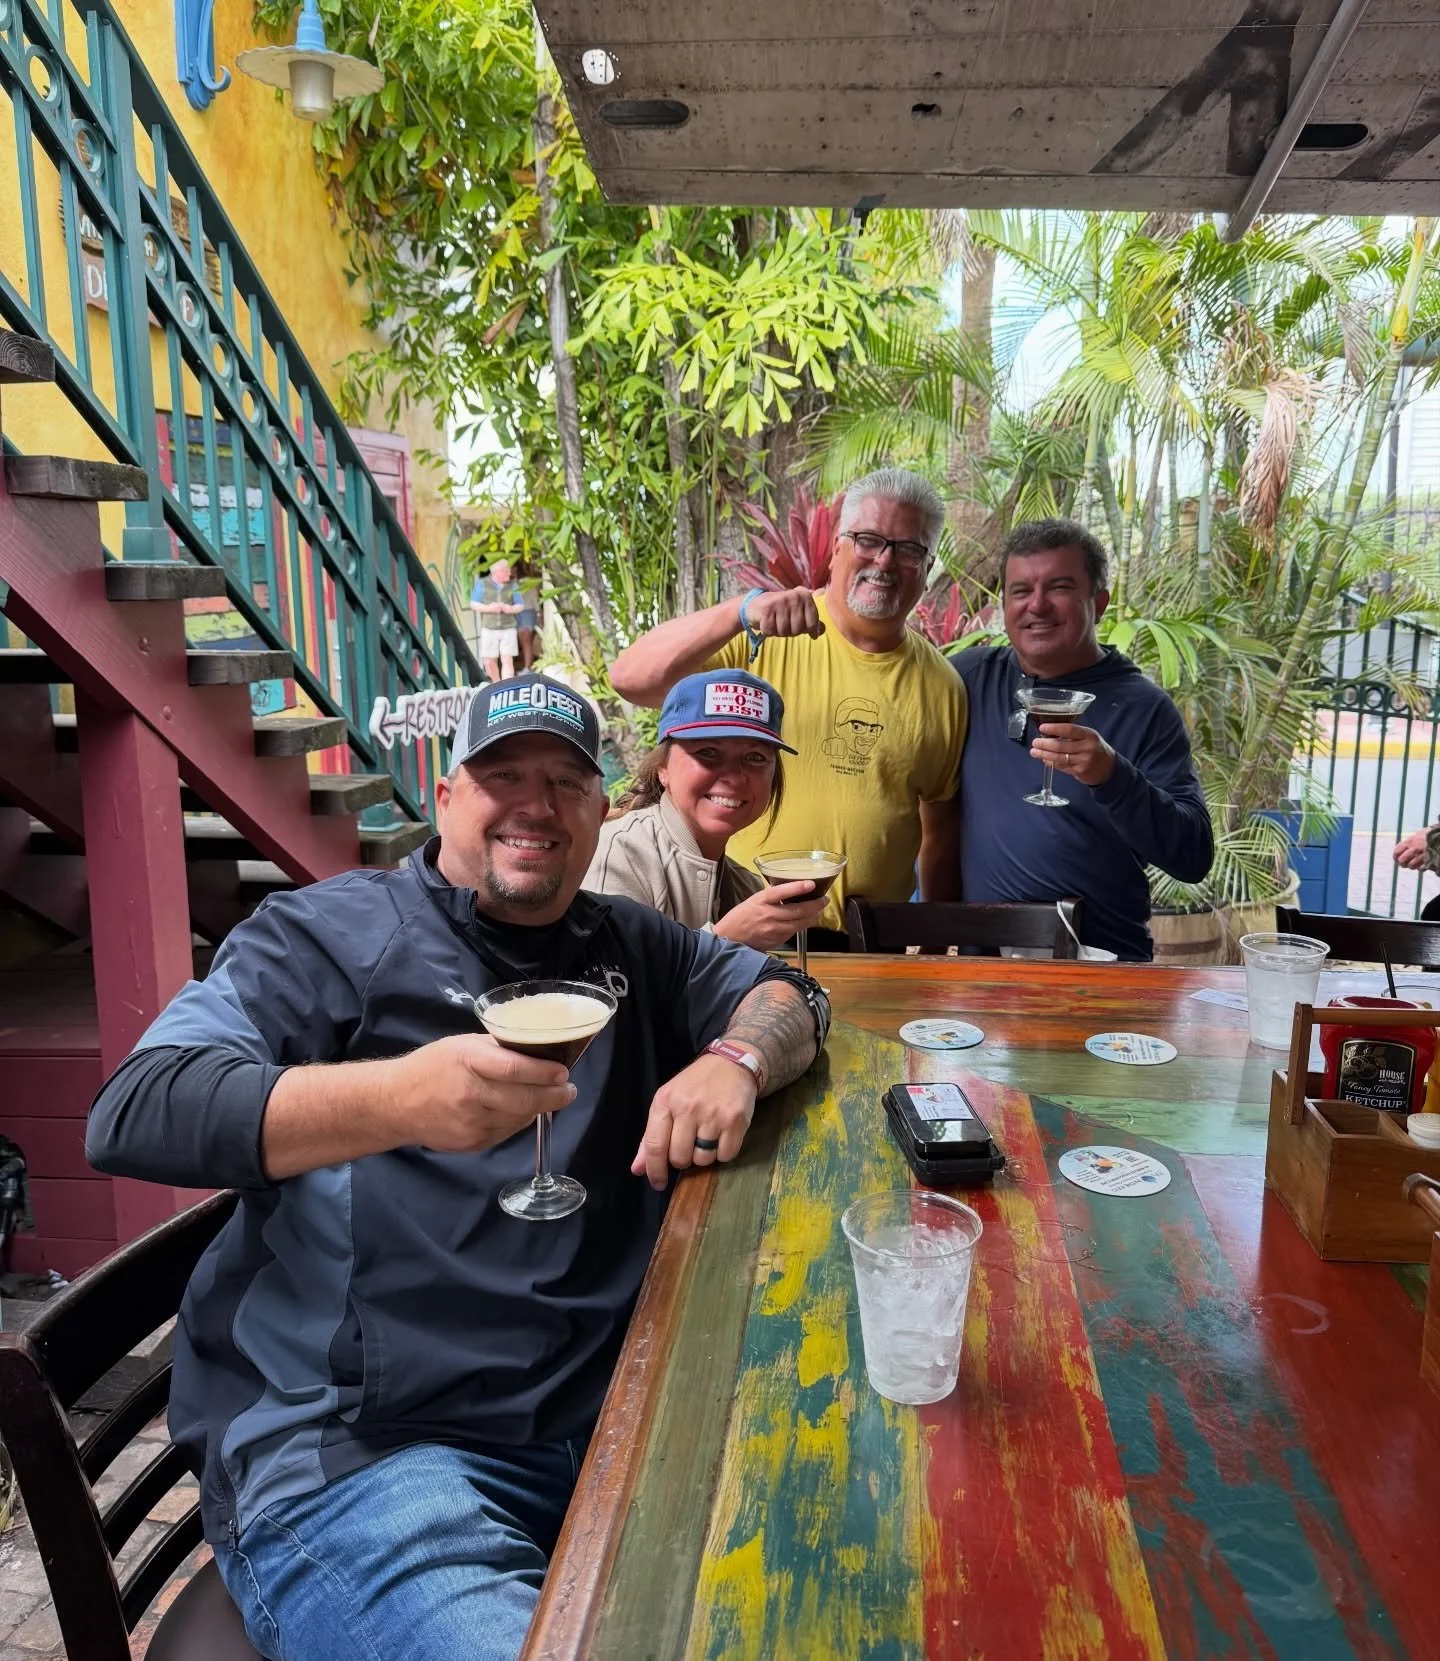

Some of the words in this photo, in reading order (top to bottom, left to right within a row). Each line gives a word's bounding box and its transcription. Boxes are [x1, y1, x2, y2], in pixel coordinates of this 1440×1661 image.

[714, 684, 763, 700] MILE
[713, 704, 763, 718] FEST
[487, 715, 505, 727] KEY
[508, 710, 539, 719] WEST
[542, 711, 584, 733] FLORIDA
[1379, 1069, 1405, 1080] HOUSE
[1347, 1081, 1372, 1093] Fancy
[1374, 1084, 1401, 1095] Tomato
[1345, 1094, 1403, 1108] KETCHUP
